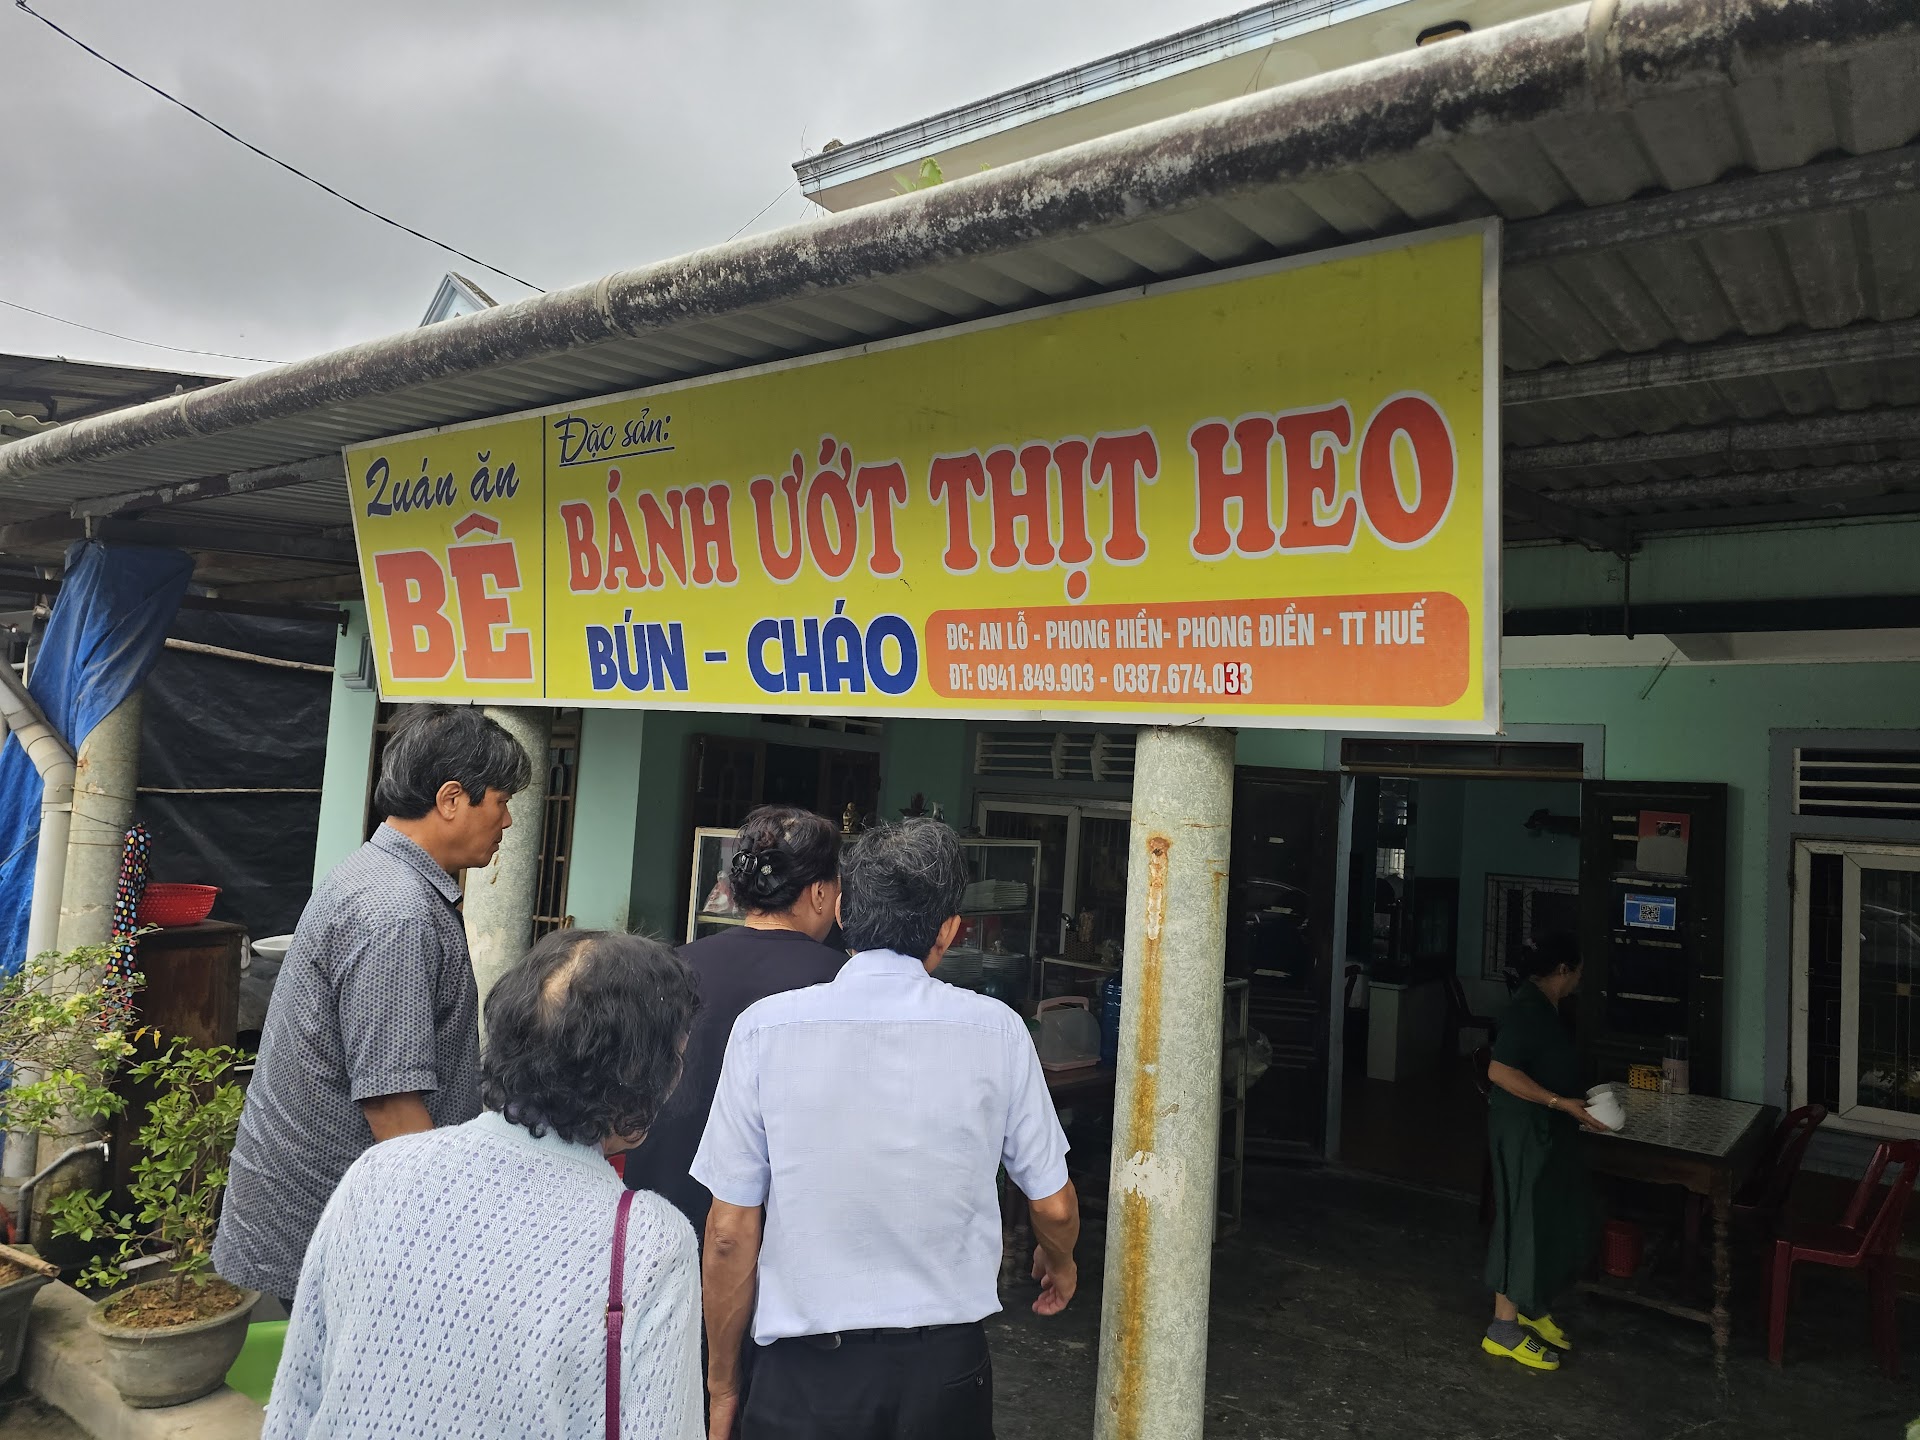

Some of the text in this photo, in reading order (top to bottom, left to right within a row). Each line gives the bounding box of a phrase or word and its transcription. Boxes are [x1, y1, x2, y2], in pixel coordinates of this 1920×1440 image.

[553, 407, 671, 464] Đặc sản:
[366, 450, 520, 517] Quán ăn
[560, 391, 1457, 603] BÁNH ƯỚT THỊT HEO
[374, 511, 534, 680] BÊ
[946, 622, 974, 650] ĐC:
[978, 622, 1003, 650] AN
[1007, 610, 1029, 650] LỖ
[1033, 633, 1041, 641] -
[1046, 619, 1110, 649] PHONG
[1177, 615, 1253, 648] PHONG
[1259, 602, 1315, 647] ĐIỀN
[1322, 627, 1332, 635] -
[1339, 611, 1367, 645] TT
[1375, 597, 1428, 645] HUẾ
[585, 599, 919, 695] BÚN - CHÁO
[949, 663, 974, 690] ĐT:
[977, 663, 1095, 692] 0941.849.903
[1113, 662, 1253, 694] 0387.674.033
